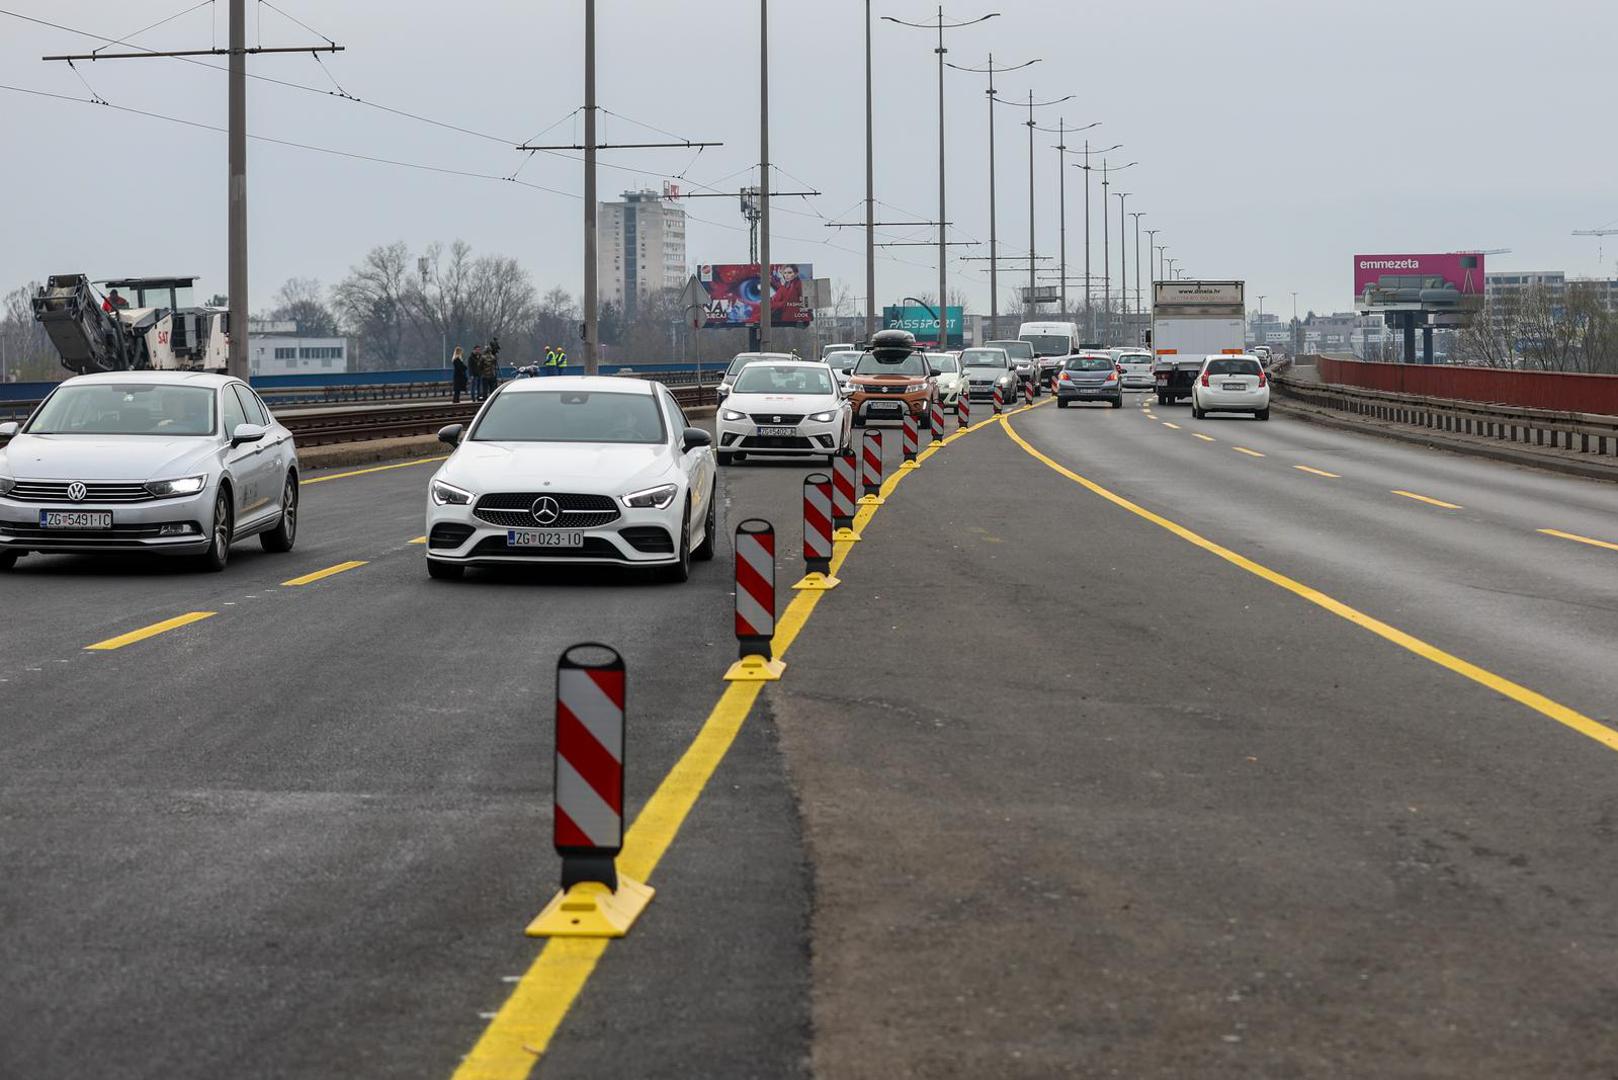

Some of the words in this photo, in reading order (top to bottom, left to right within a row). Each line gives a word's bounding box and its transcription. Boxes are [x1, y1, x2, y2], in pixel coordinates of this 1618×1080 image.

[1360, 259, 1419, 269] emmezeta
[48, 513, 61, 526] ZG
[516, 532, 530, 545] ZG
